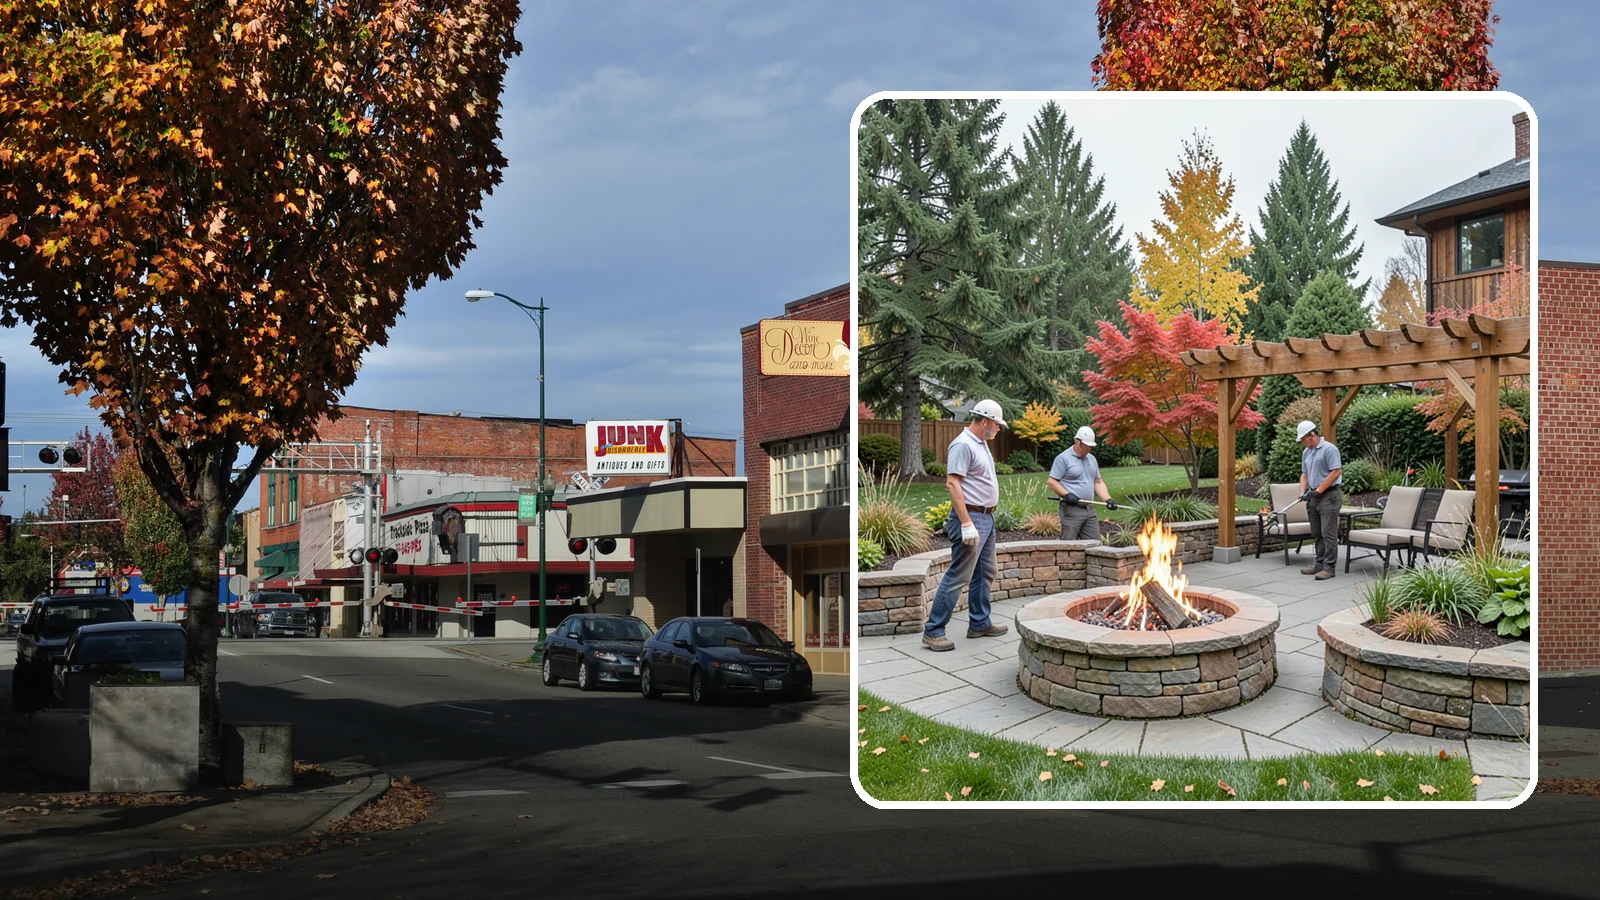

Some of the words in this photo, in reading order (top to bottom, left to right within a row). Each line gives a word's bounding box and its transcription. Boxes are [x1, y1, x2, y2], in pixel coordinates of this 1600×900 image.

[595, 425, 665, 457] JUNK
[607, 446, 646, 454] DISORDERLY
[597, 461, 628, 470] ANTIQUES
[631, 461, 644, 470] AND
[647, 460, 665, 469] GIFTS
[390, 521, 413, 540] Trackside
[414, 520, 429, 535] Pizza
